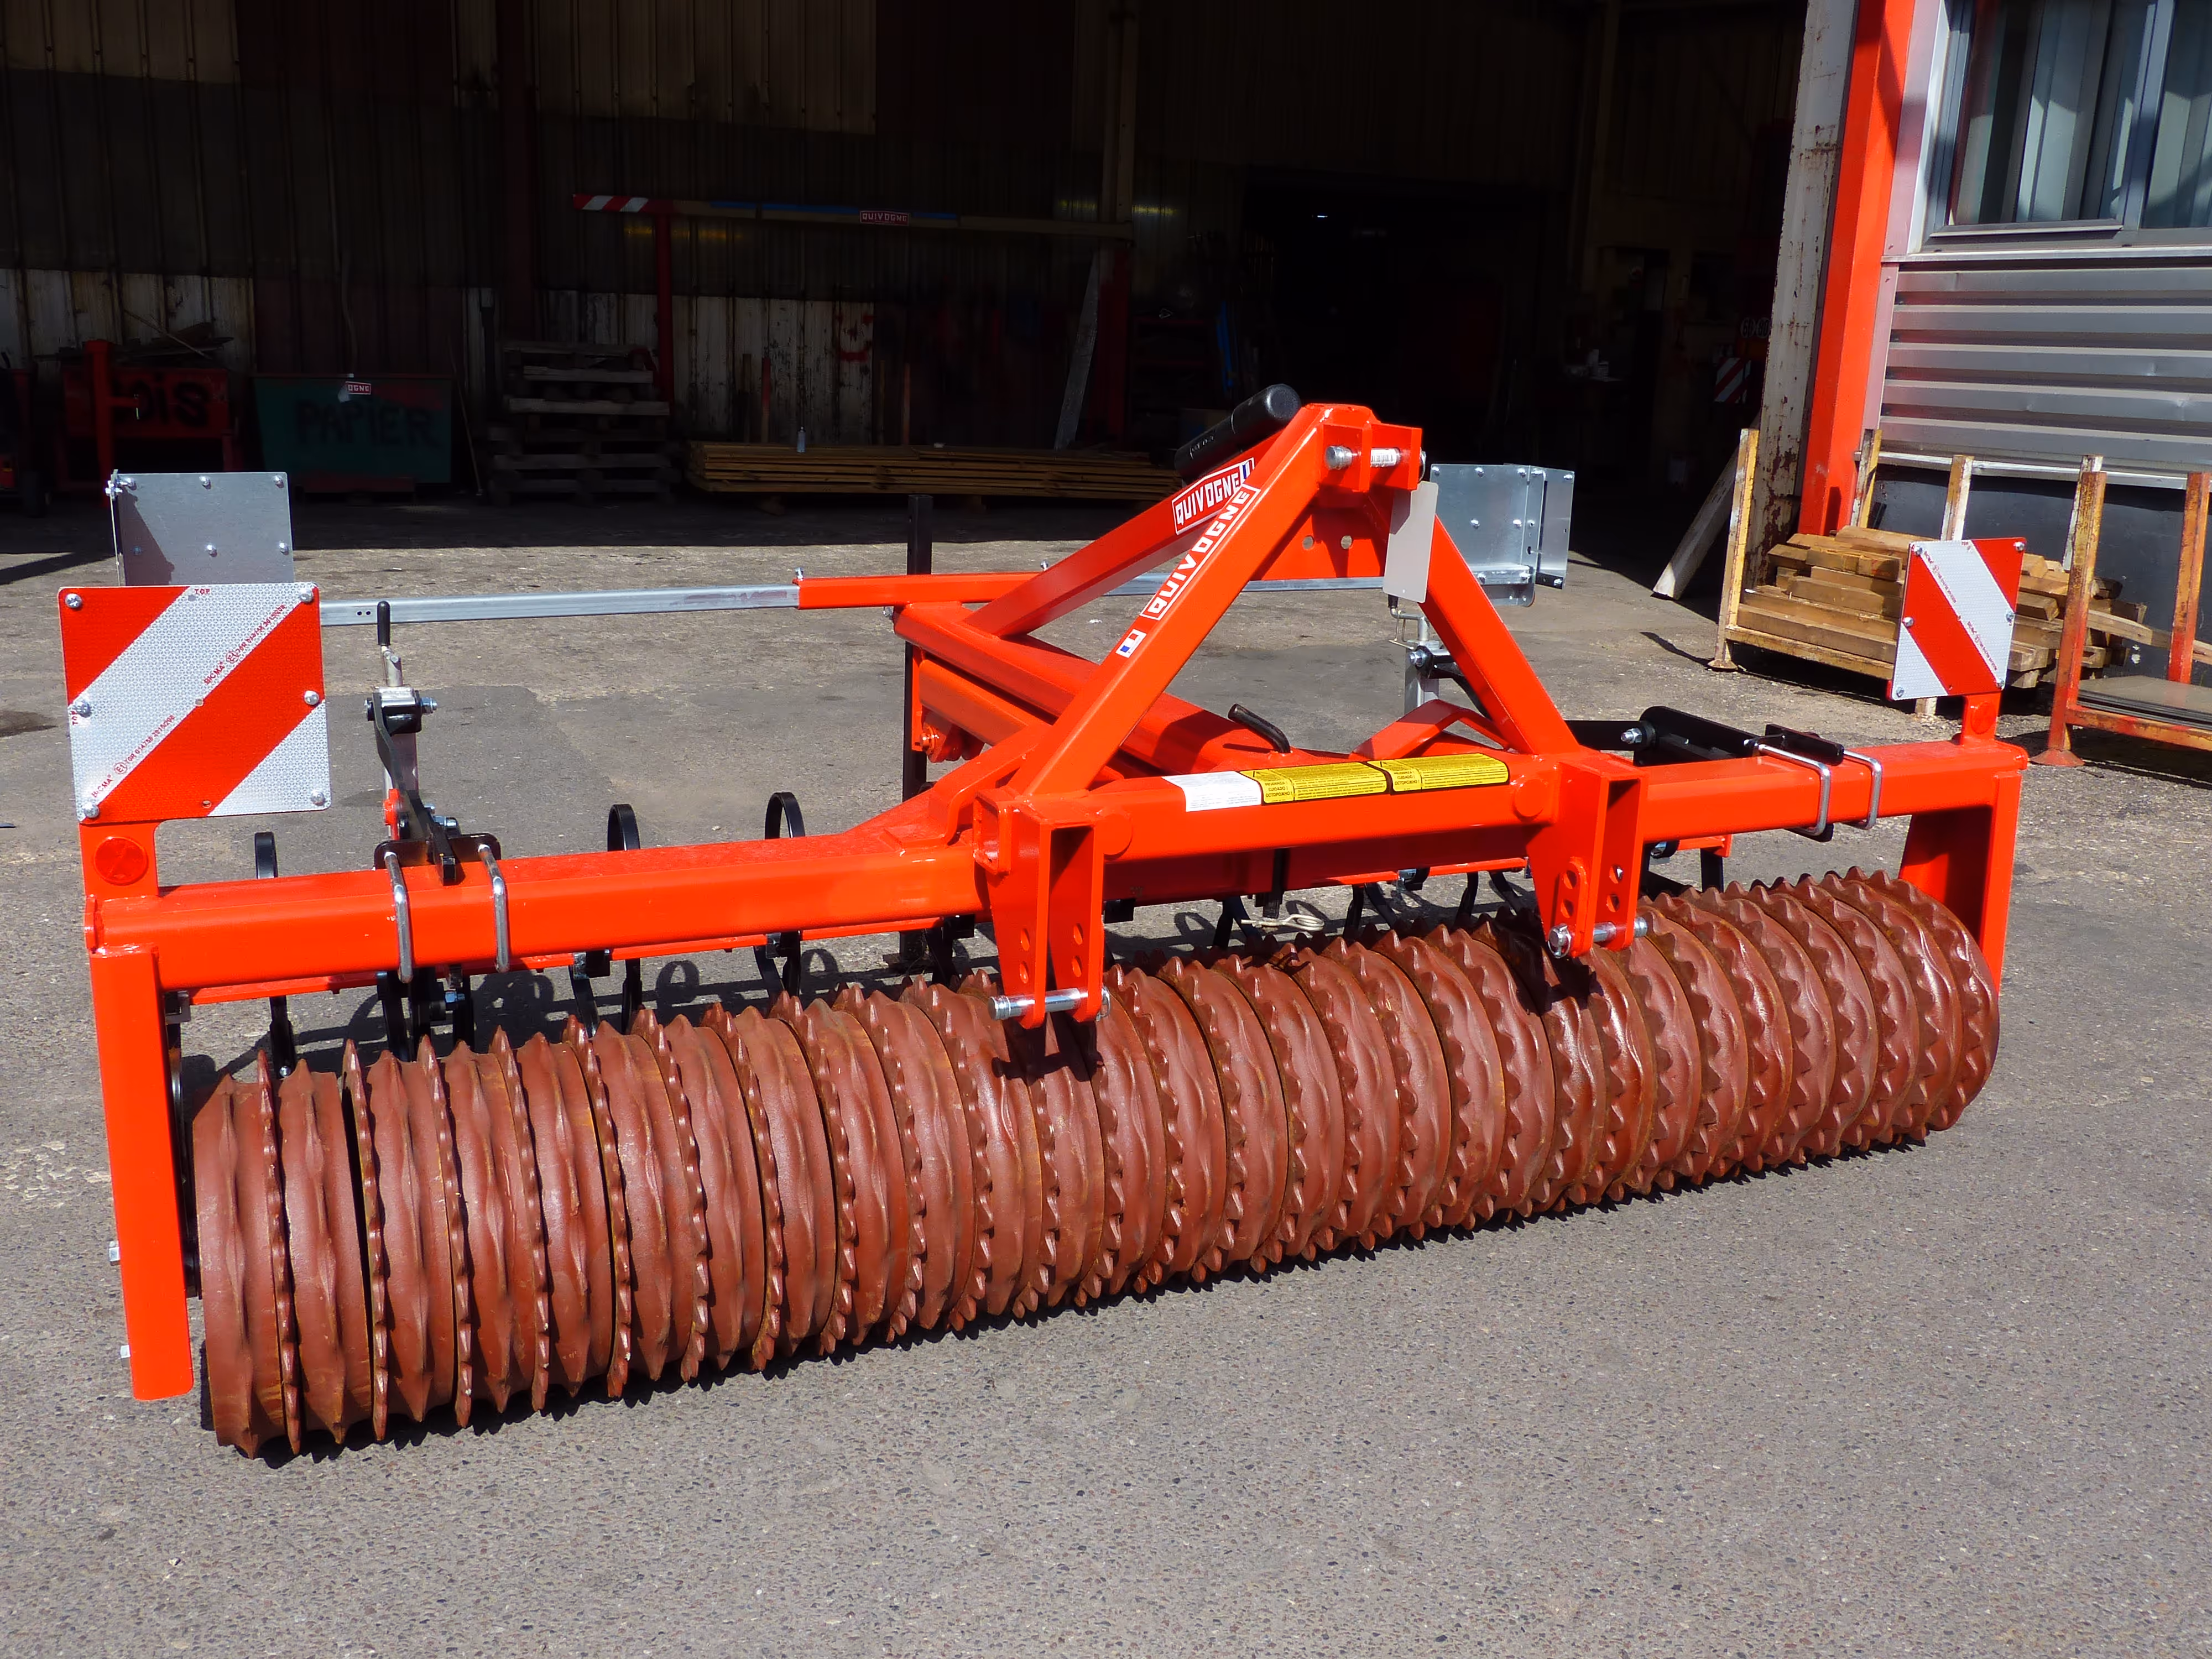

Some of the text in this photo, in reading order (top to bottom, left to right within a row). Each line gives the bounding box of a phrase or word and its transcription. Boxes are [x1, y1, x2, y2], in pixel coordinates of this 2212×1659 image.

[862, 212, 907, 222] QUIVOGNE
[1175, 472, 1240, 525] QUIVOGNE
[1147, 491, 1250, 614] QUIVOGNE
